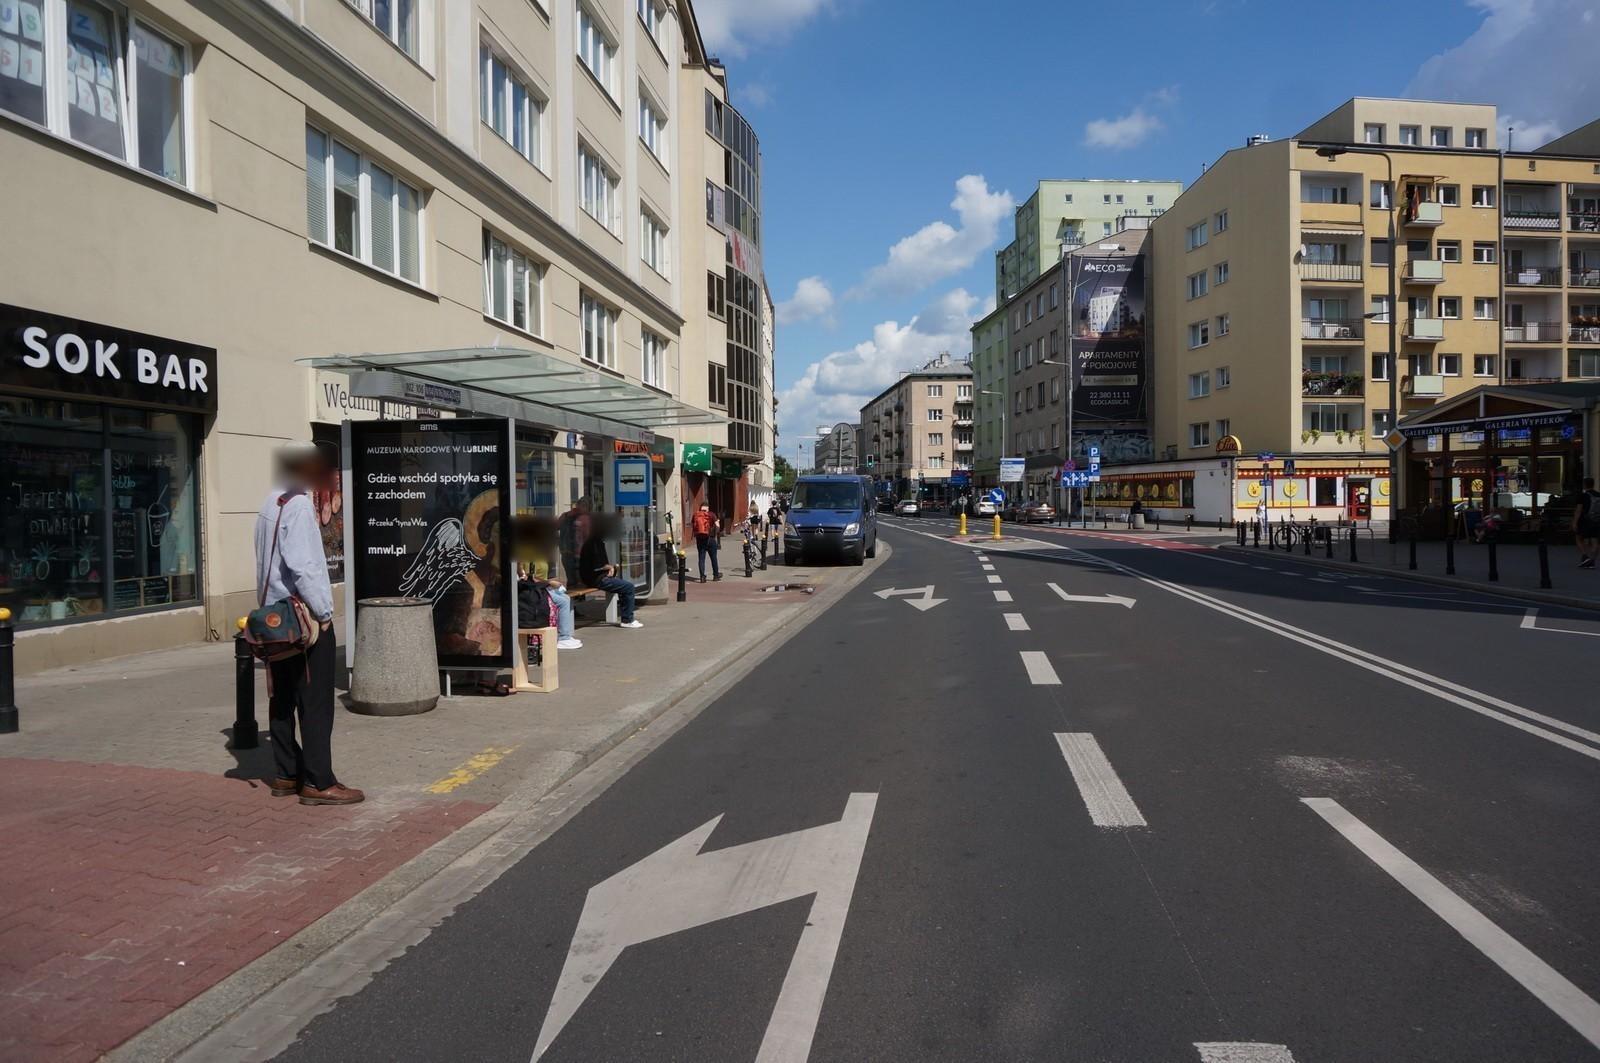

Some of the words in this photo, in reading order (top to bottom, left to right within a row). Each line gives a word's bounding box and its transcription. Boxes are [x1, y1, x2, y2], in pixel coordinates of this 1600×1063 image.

[1095, 264, 1116, 273] ECO
[23, 326, 121, 379] SOK
[137, 348, 208, 393] BAR
[1078, 351, 1140, 360] APARTAMENTY
[420, 423, 438, 431] ams
[1485, 420, 1520, 430] GALERIA
[367, 446, 401, 455] MUZEUM
[403, 445, 450, 454] NARODOWE
[451, 445, 461, 453] W
[462, 445, 497, 453] LUBLINIE
[1091, 447, 1098, 457] P
[1091, 463, 1098, 473] P
[367, 472, 397, 484] Gdzie
[399, 472, 437, 484] wschód
[440, 472, 480, 484] spotyka
[482, 472, 497, 485] się
[367, 491, 374, 500] z
[375, 490, 426, 500] zachodem
[368, 544, 406, 556] mnwl.pl
